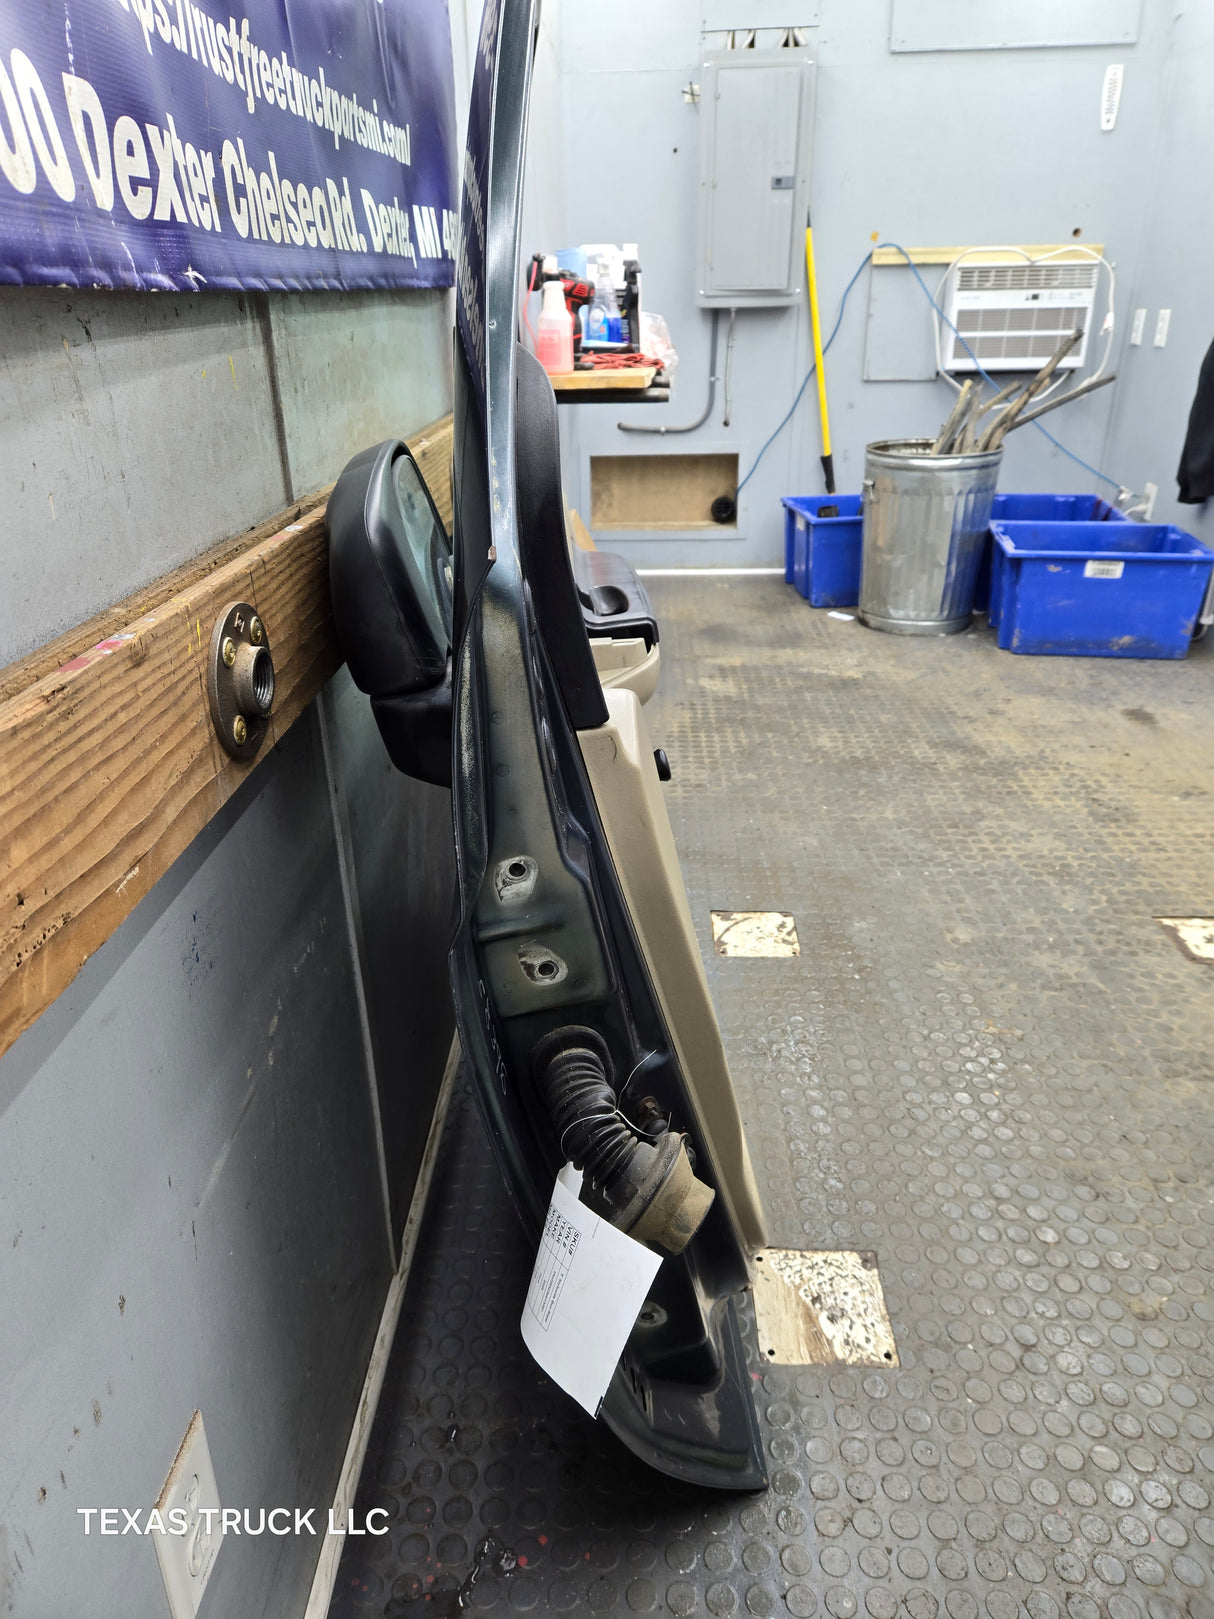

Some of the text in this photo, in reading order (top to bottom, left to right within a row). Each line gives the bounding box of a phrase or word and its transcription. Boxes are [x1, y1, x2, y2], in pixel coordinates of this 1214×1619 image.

[61, 72, 222, 232] Dexter
[221, 137, 335, 249] Chelsea
[326, 176, 368, 253] Rd.
[412, 204, 442, 259] MI
